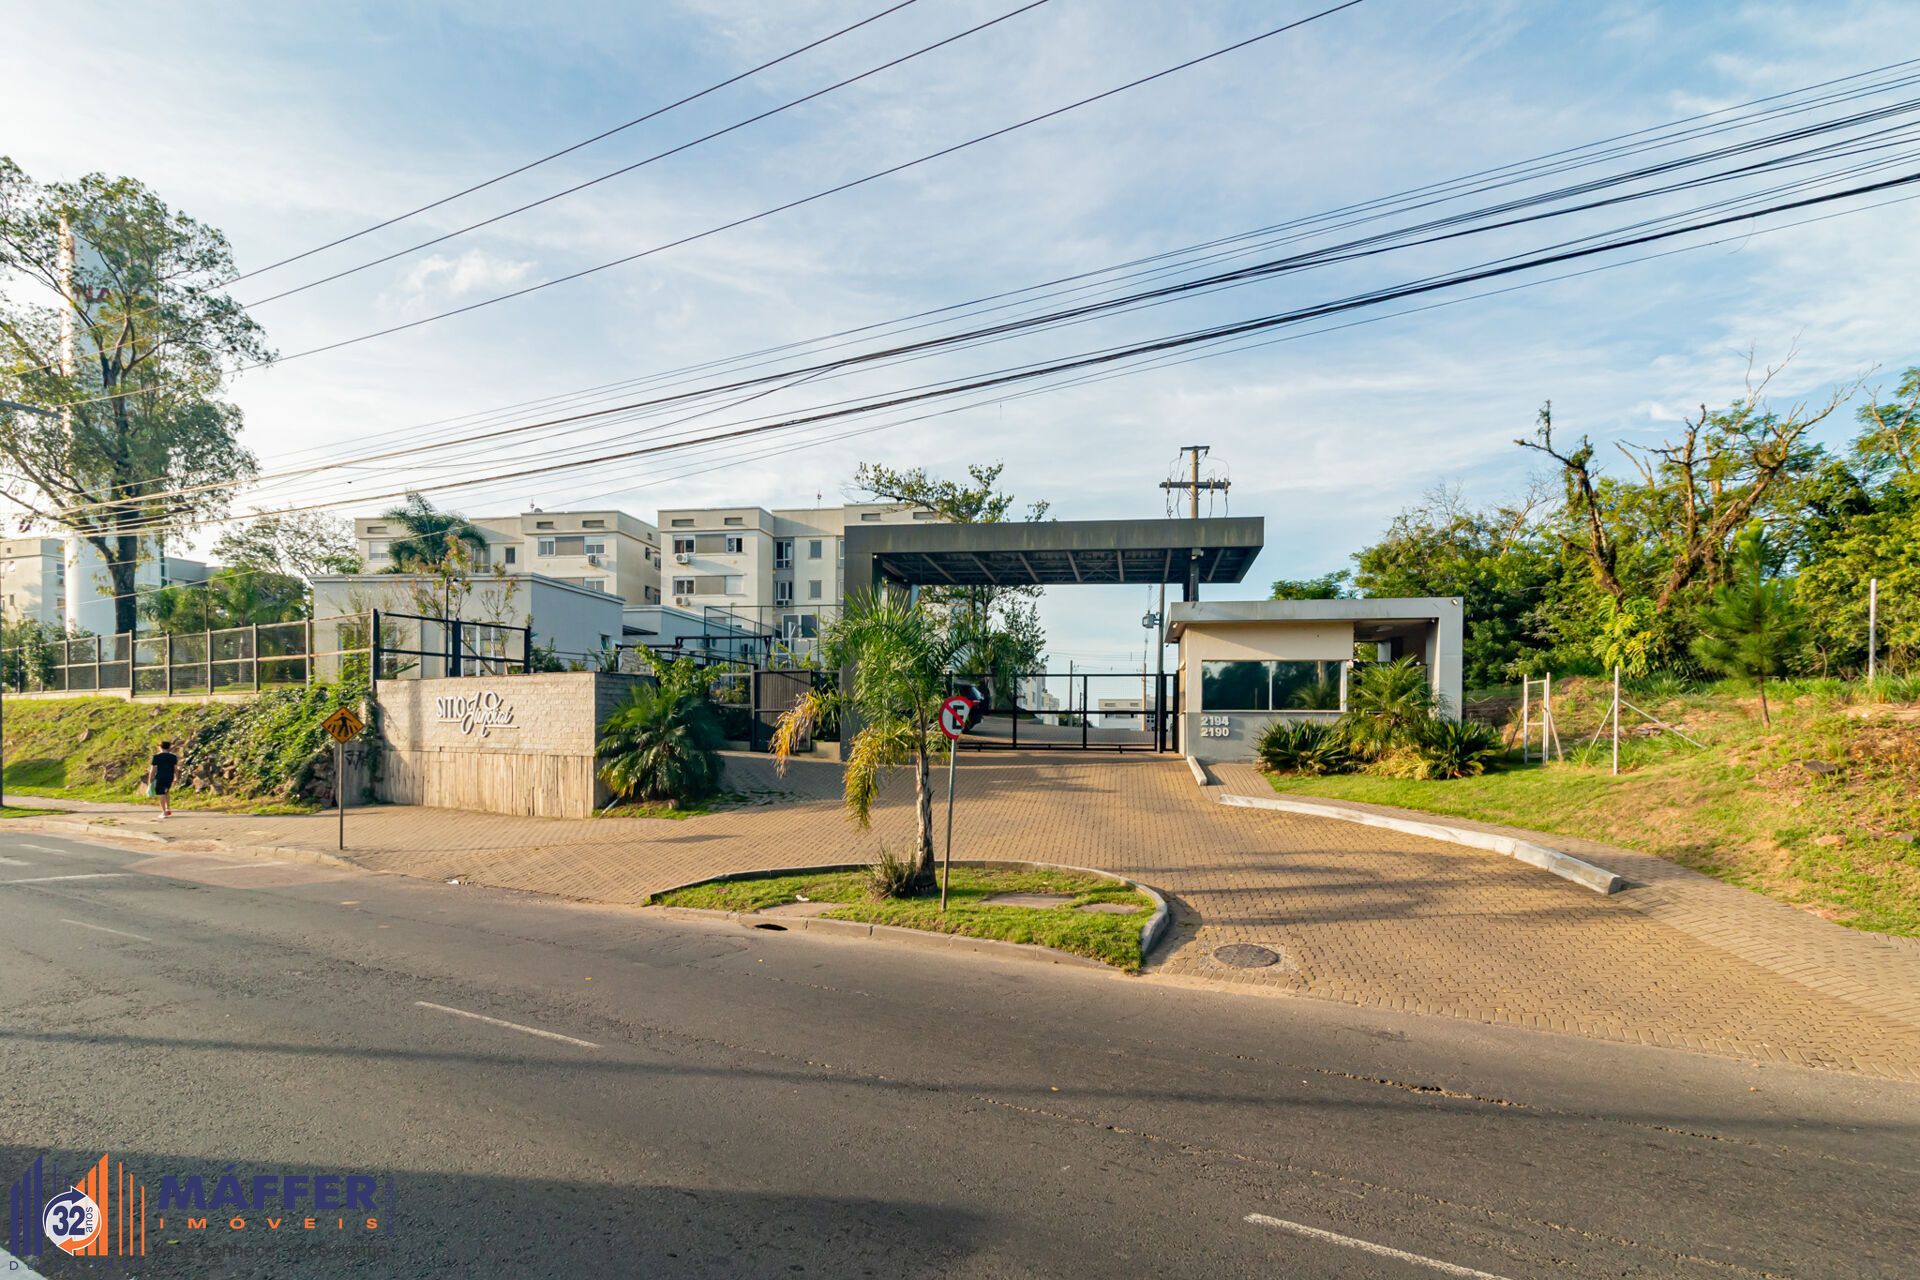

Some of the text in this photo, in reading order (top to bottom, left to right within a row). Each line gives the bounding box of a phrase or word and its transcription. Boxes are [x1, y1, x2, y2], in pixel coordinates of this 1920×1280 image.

[952, 704, 965, 730] E
[1200, 715, 1230, 727] 2194
[1200, 727, 1230, 738] 2190
